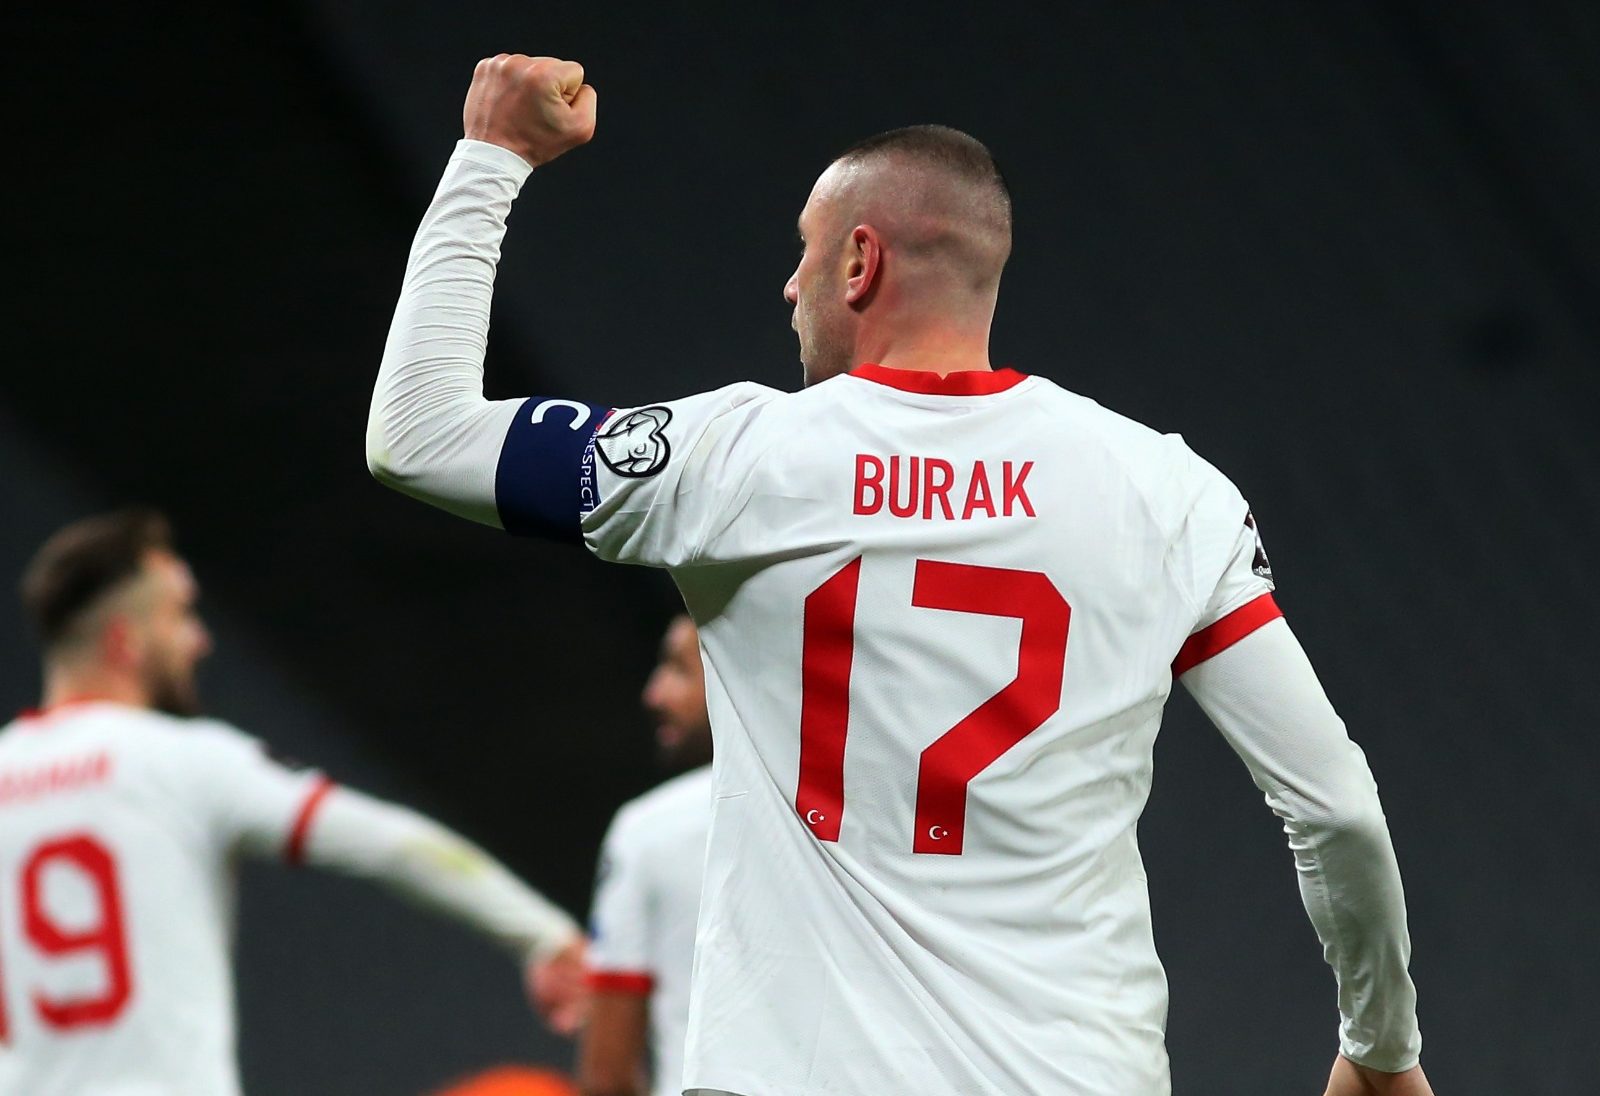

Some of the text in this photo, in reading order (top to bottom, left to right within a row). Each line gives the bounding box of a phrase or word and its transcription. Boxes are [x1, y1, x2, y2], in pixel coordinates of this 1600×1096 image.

[531, 399, 591, 431] C
[852, 453, 1037, 521] BURAK
[794, 553, 1073, 856] 17
[0, 831, 134, 1046] 9
